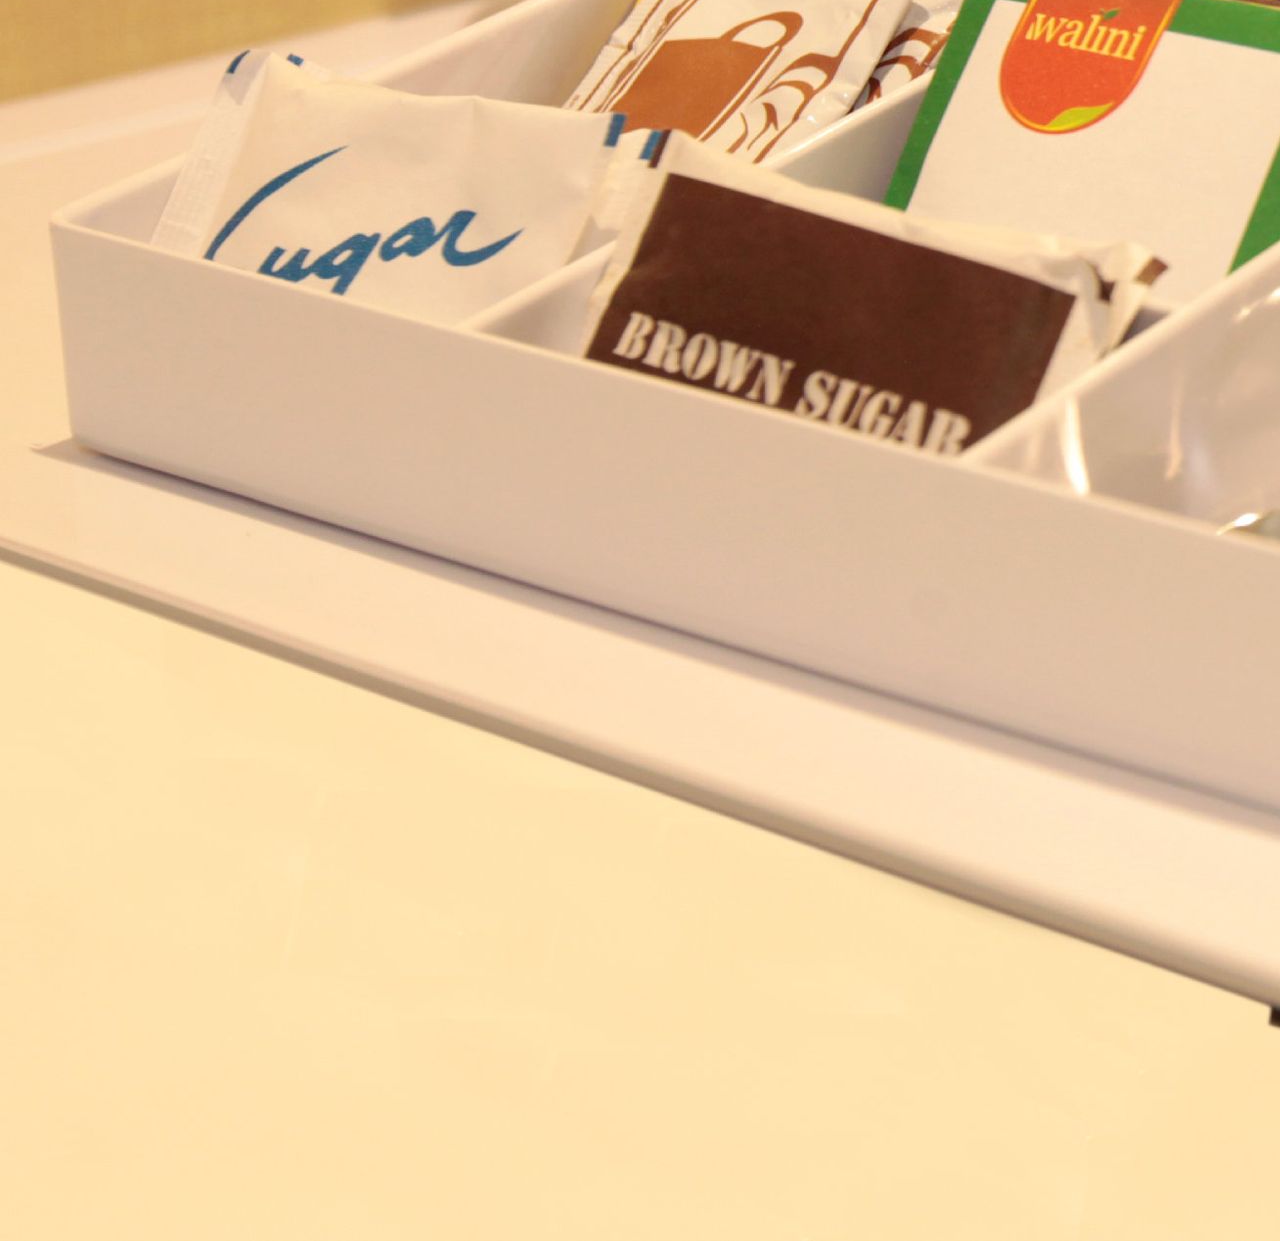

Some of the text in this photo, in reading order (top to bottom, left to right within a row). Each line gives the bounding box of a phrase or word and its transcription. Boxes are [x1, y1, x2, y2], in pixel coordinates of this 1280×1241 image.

[1025, 12, 1147, 61] walini
[611, 311, 971, 457] BROWN SUGAR
